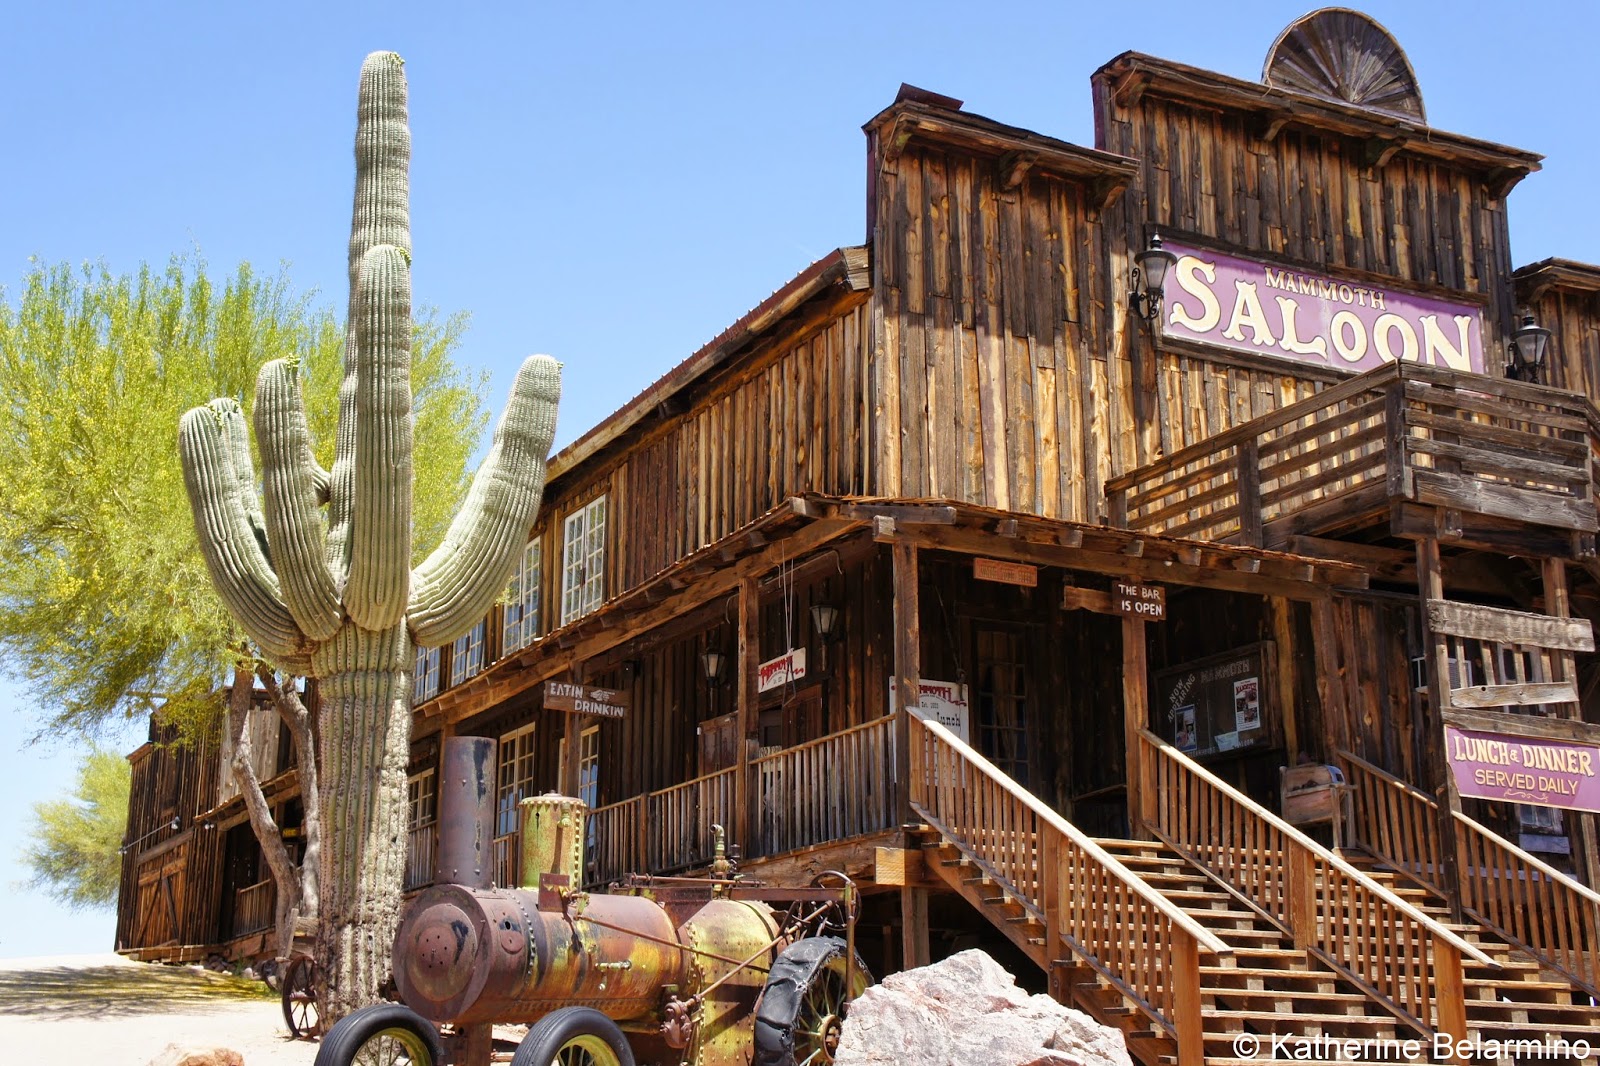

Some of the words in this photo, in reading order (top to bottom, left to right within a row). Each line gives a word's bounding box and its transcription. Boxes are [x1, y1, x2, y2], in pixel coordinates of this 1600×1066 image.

[1265, 267, 1386, 311] MAMMOTH
[1171, 255, 1472, 373] SALOON
[1118, 584, 1137, 596] THE
[1141, 588, 1160, 600] BAR
[1121, 600, 1131, 612] IS
[1134, 601, 1162, 616] OPEN
[550, 682, 584, 698] EATIN
[919, 685, 952, 701] MMOTH
[1167, 673, 1196, 723] APPEARING
[1168, 679, 1184, 704] NOW
[574, 700, 624, 717] DRINKIN
[937, 711, 961, 726] Lunch
[1453, 736, 1510, 766] LUNCH
[1510, 749, 1519, 763] &
[1521, 744, 1595, 777] DINNER
[1474, 769, 1535, 791] SERVED
[1539, 776, 1579, 795] DAILY
